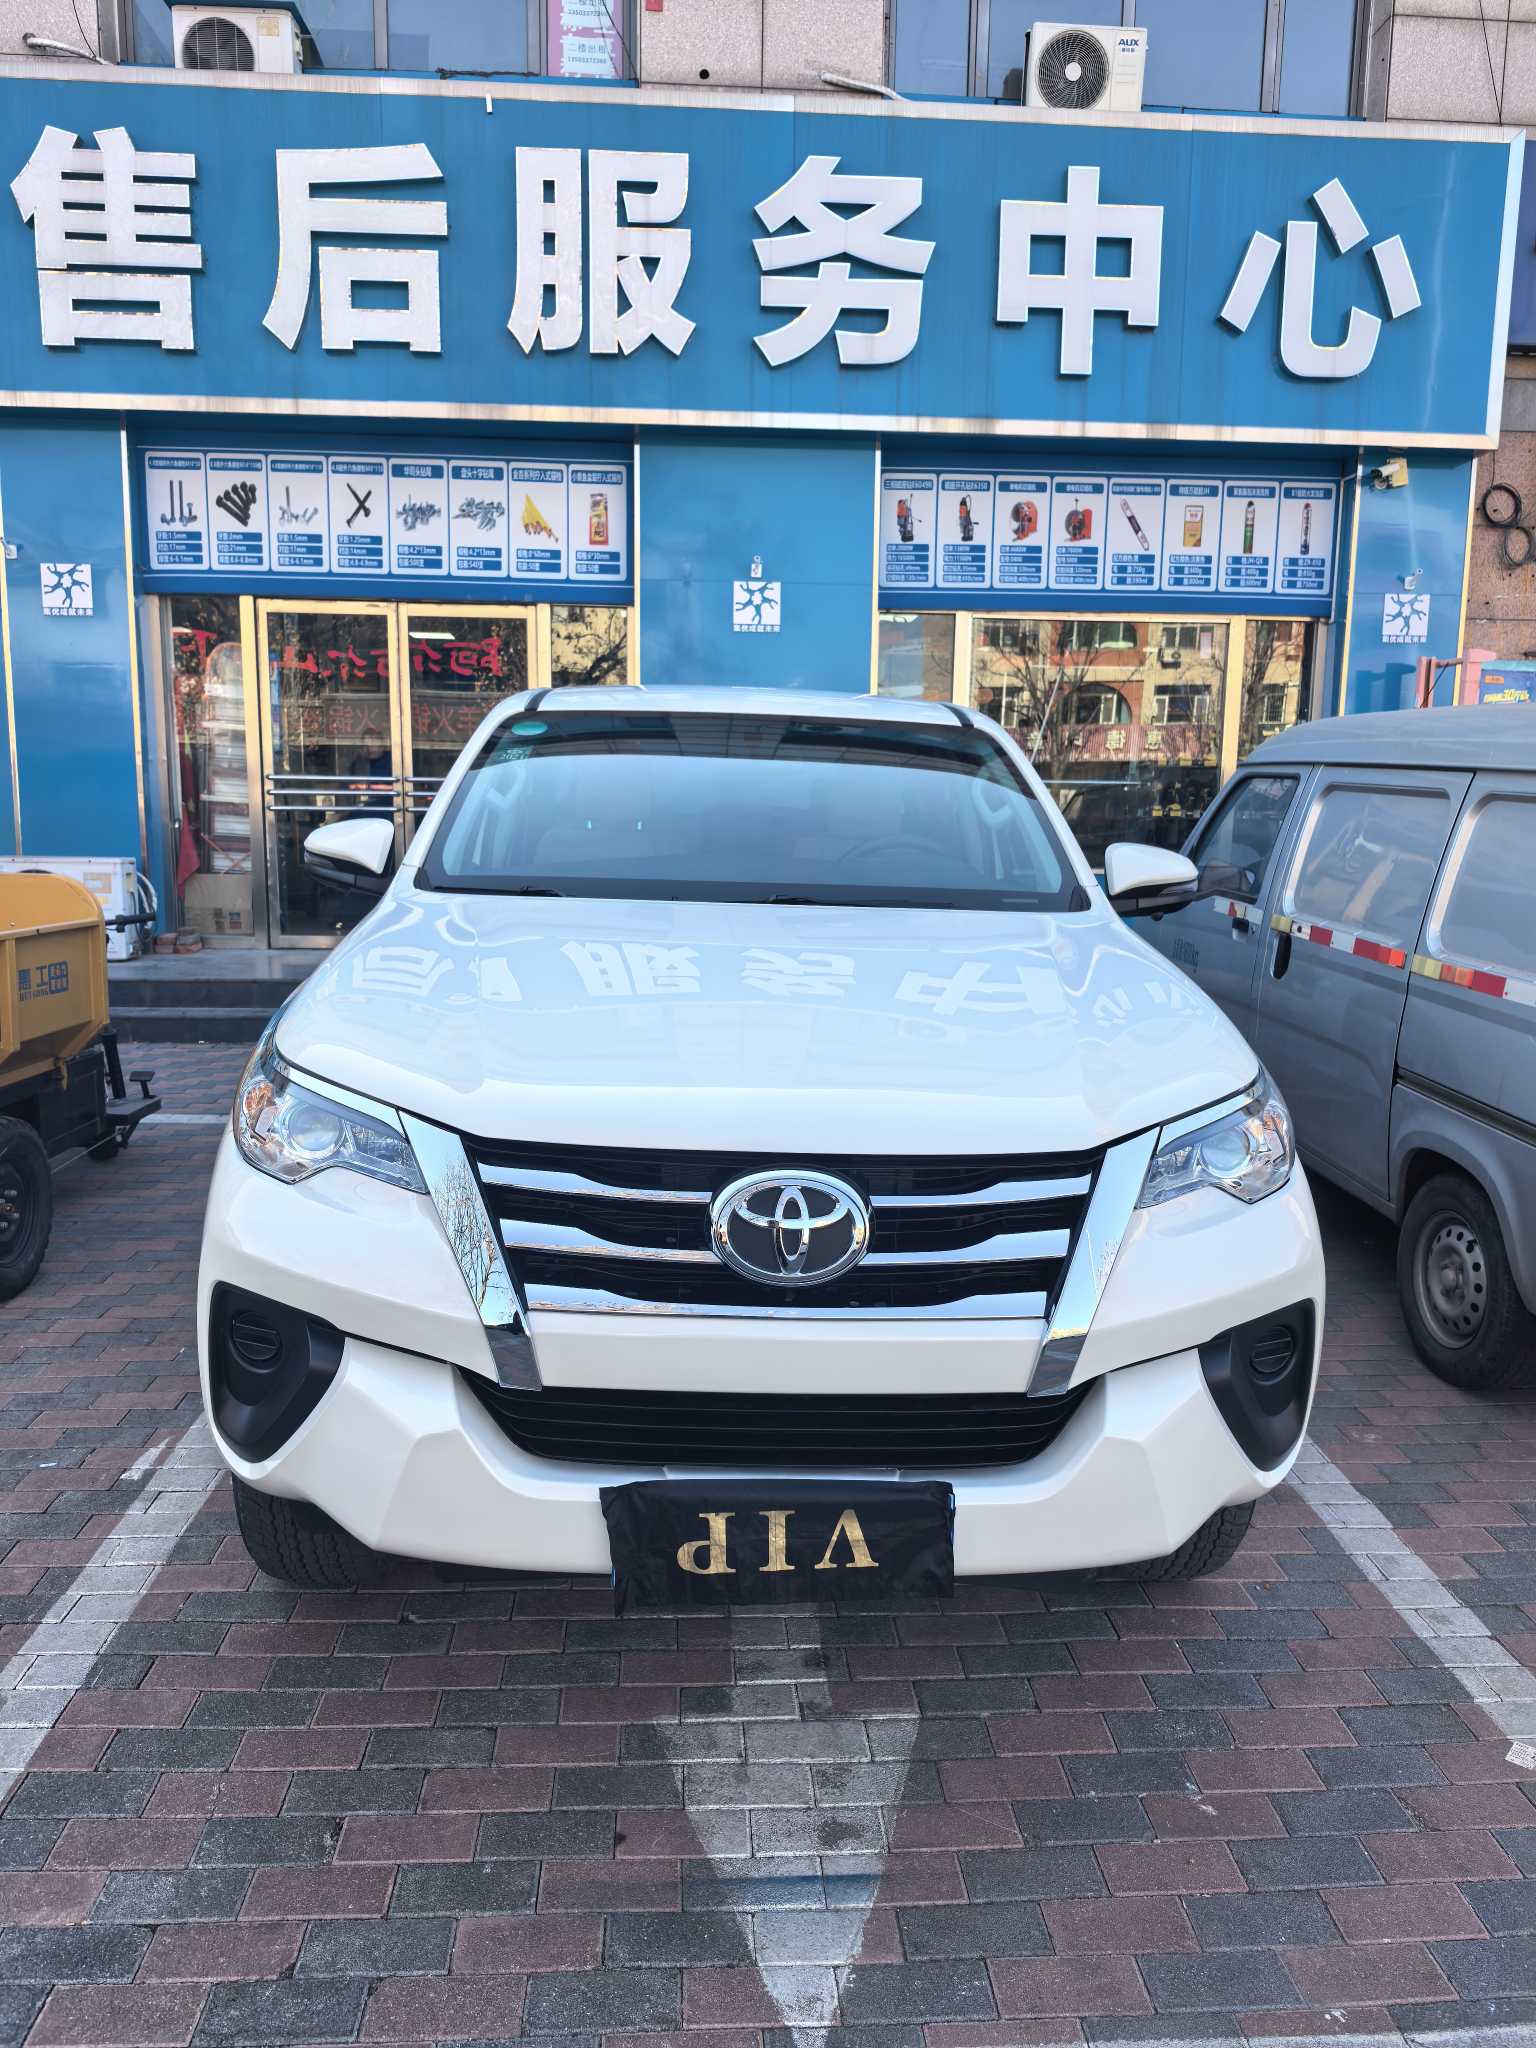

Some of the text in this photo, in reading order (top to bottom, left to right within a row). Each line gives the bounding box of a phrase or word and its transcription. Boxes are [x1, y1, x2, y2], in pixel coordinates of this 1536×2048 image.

[1118, 38, 1139, 46] AUX
[10, 124, 1422, 379] 售后服务中心
[675, 1508, 880, 1576] VIP
